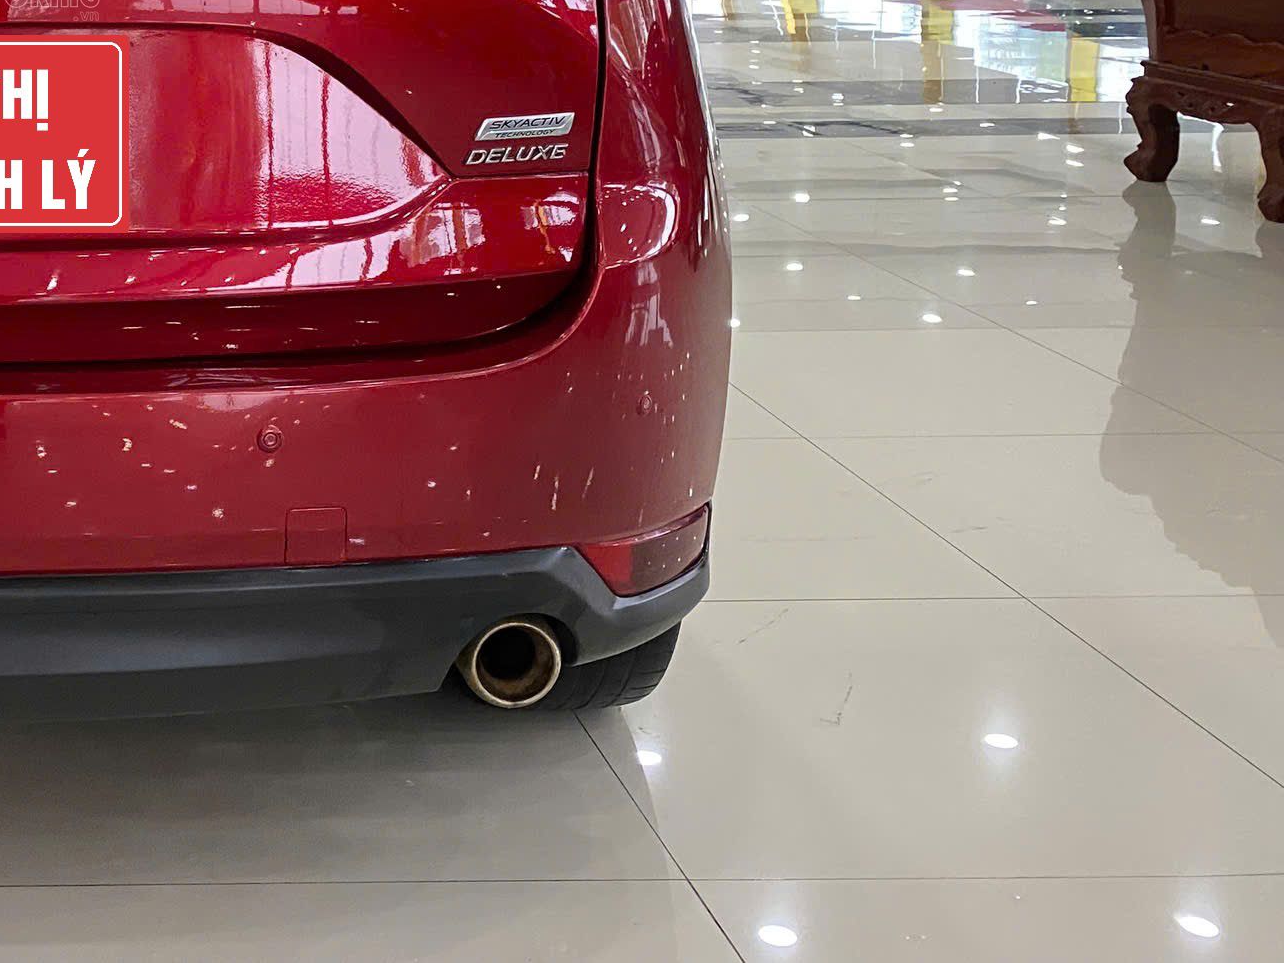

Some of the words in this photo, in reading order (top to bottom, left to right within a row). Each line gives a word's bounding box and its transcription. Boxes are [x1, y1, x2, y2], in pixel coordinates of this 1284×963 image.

[489, 115, 567, 130] SKYACTIV
[494, 128, 557, 139] TECHNOLOGY
[464, 143, 569, 166] DELUXE
